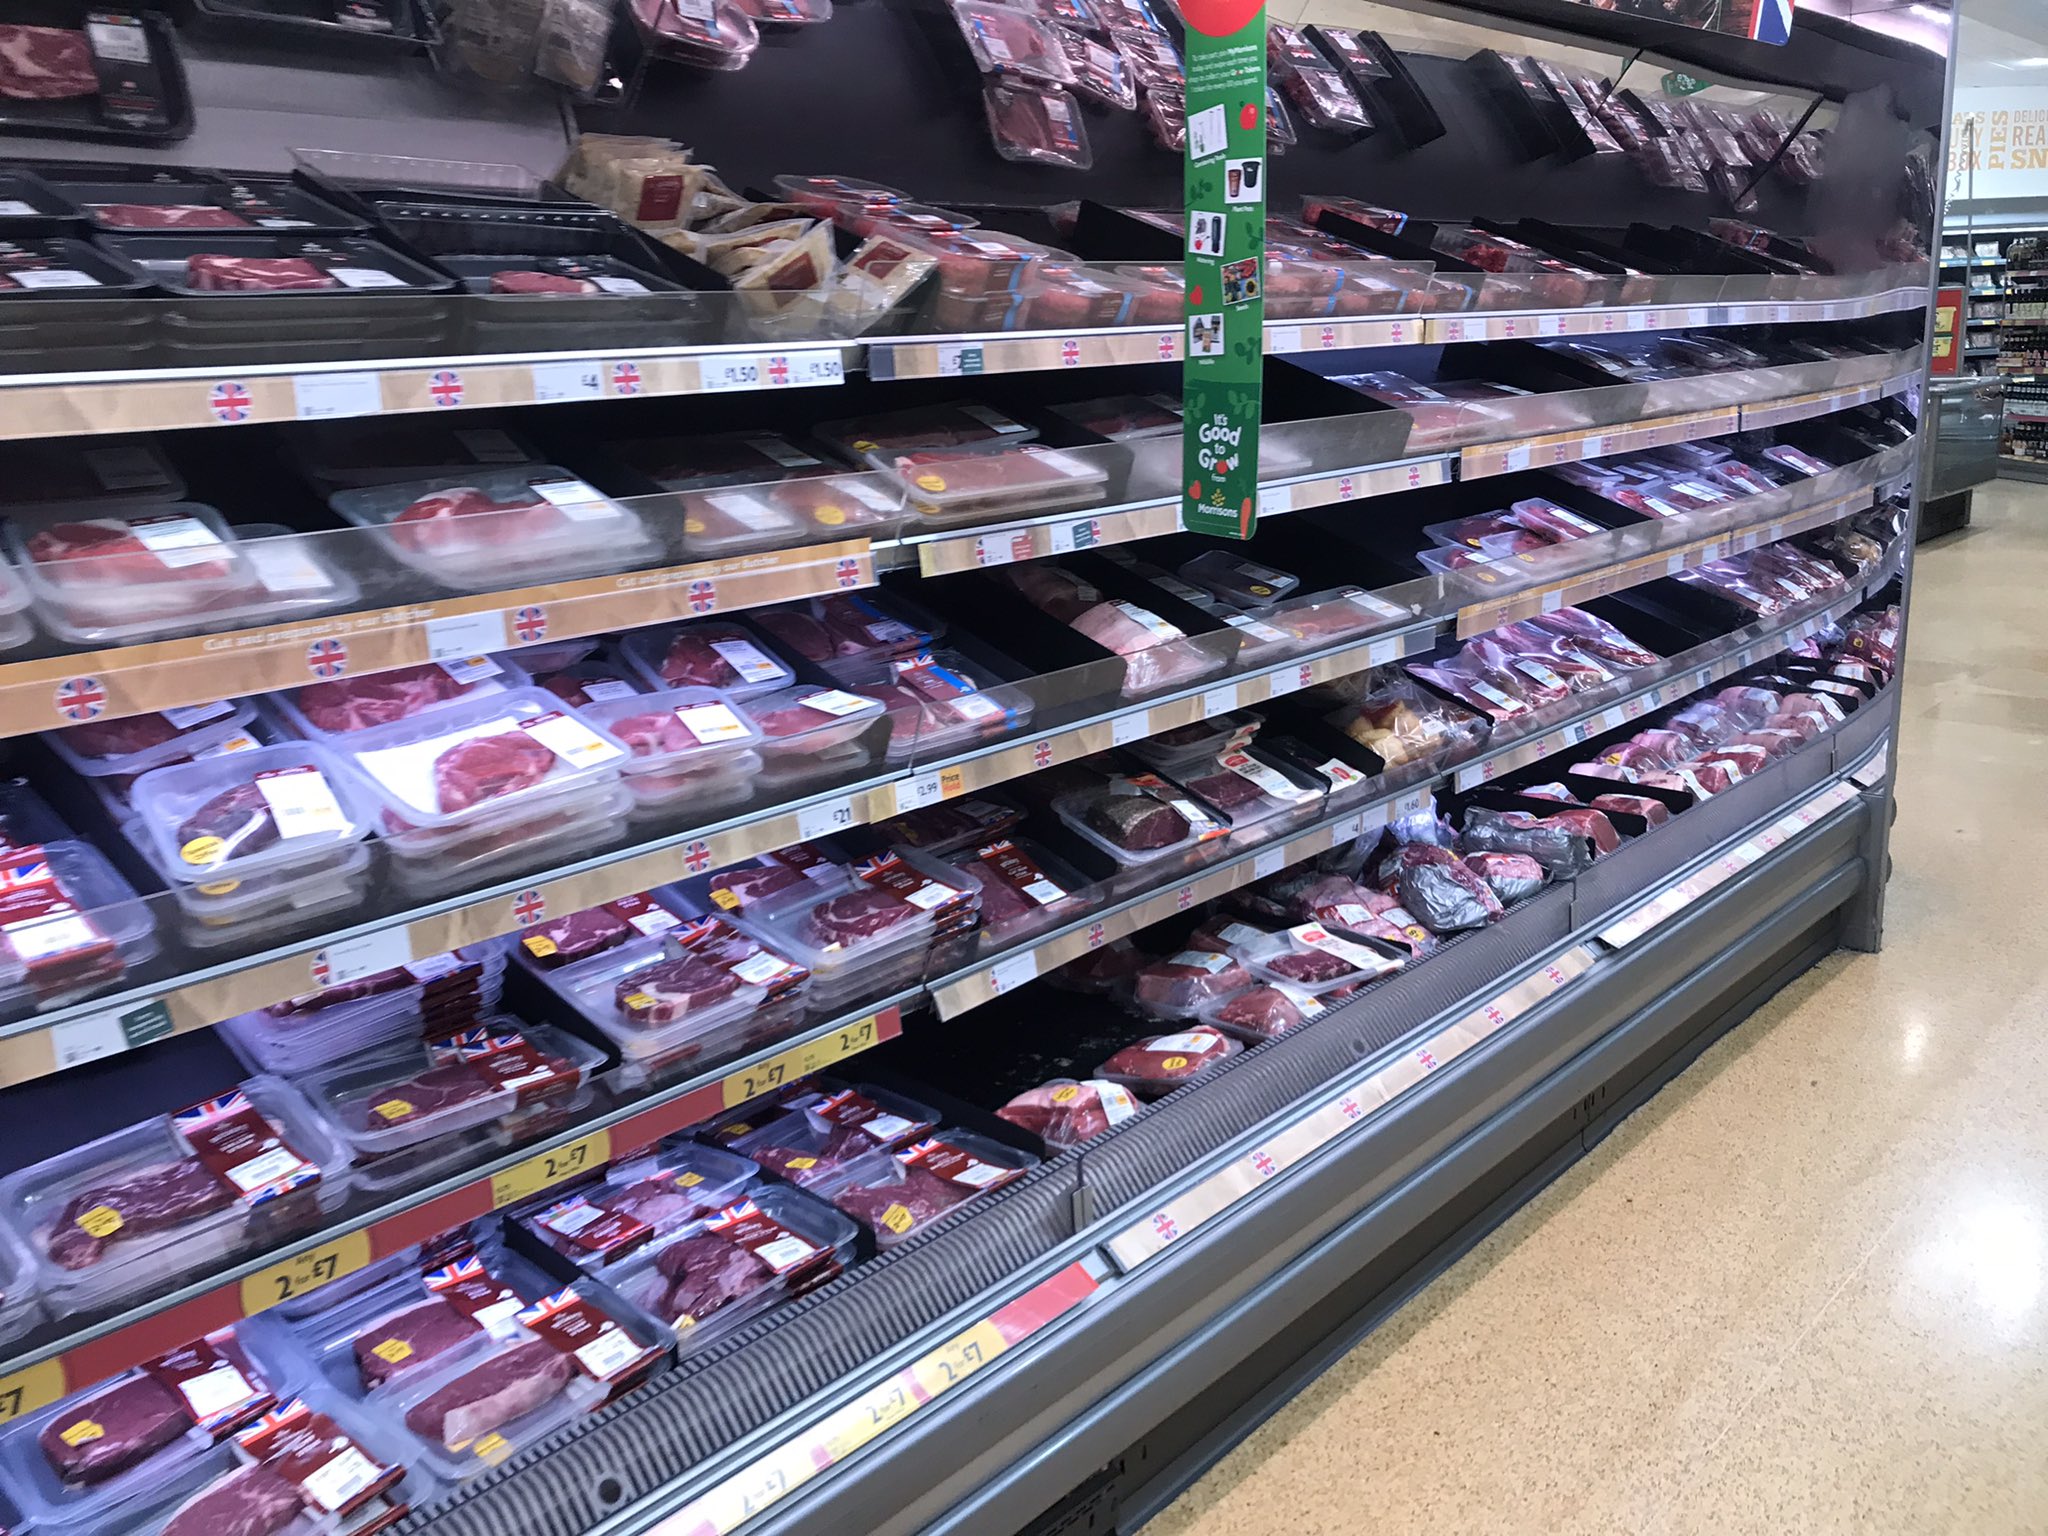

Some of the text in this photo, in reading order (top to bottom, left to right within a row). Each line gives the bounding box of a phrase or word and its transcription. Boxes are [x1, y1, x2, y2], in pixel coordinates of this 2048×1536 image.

[1988, 110, 2009, 170] PIES
[724, 365, 758, 383] £1.50
[1213, 413, 1228, 426] It's
[1199, 423, 1242, 447] Good
[1214, 442, 1226, 455] to
[1198, 448, 1239, 475] Grow
[1197, 502, 1239, 519] Morrisons
[840, 1033, 851, 1051] 2
[859, 1023, 872, 1041] £7
[744, 1078, 756, 1098] 2
[768, 1063, 785, 1084] £7
[544, 1158, 558, 1178] 2
[569, 1143, 588, 1165] £7
[275, 1275, 294, 1300] 2
[312, 1253, 339, 1280] £7
[938, 1361, 957, 1382] 2
[963, 1341, 983, 1362] £7
[865, 1406, 883, 1424] 2
